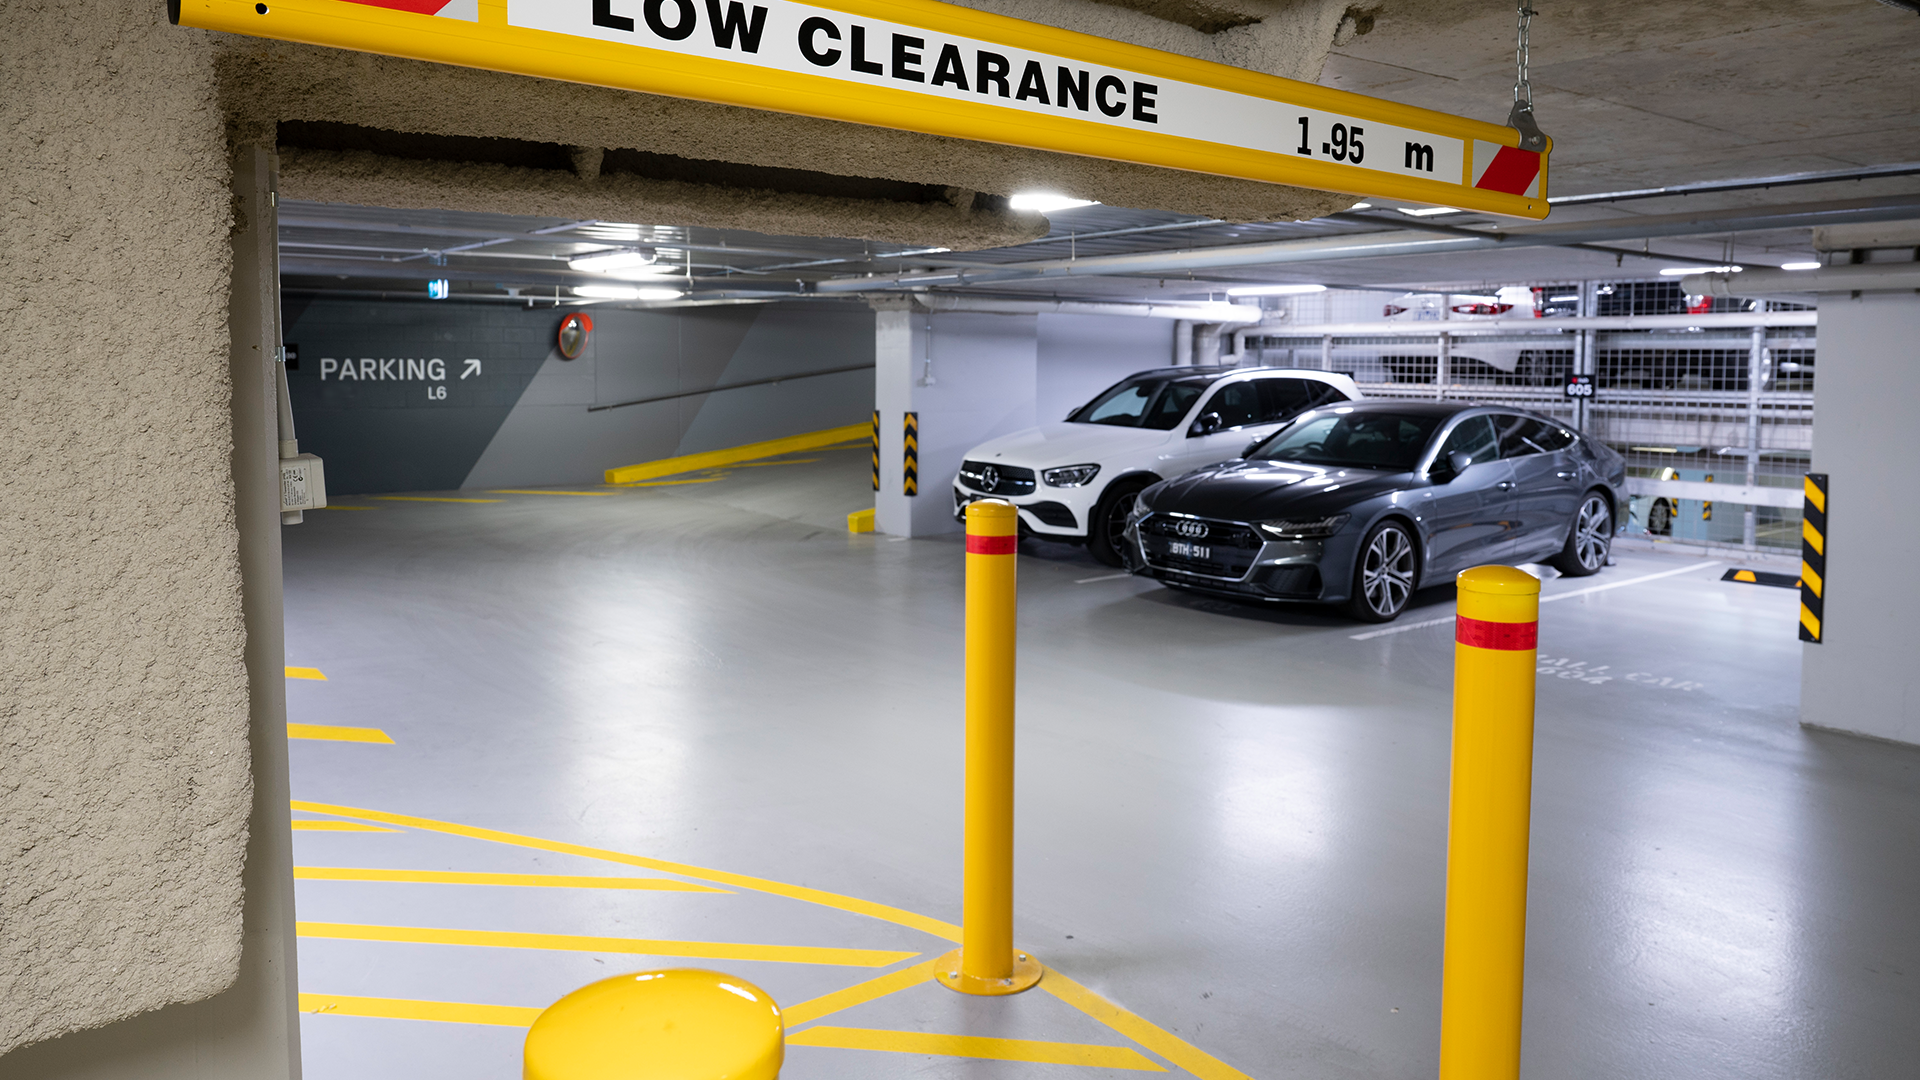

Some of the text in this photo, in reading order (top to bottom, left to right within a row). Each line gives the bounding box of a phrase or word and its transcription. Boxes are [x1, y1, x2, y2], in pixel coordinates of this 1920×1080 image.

[592, 0, 1158, 124] LOW CLEARANCE
[1297, 116, 1435, 172] 1.95 m
[320, 358, 446, 381] PARKING
[427, 386, 447, 400] L6
[1567, 384, 1593, 396] 605
